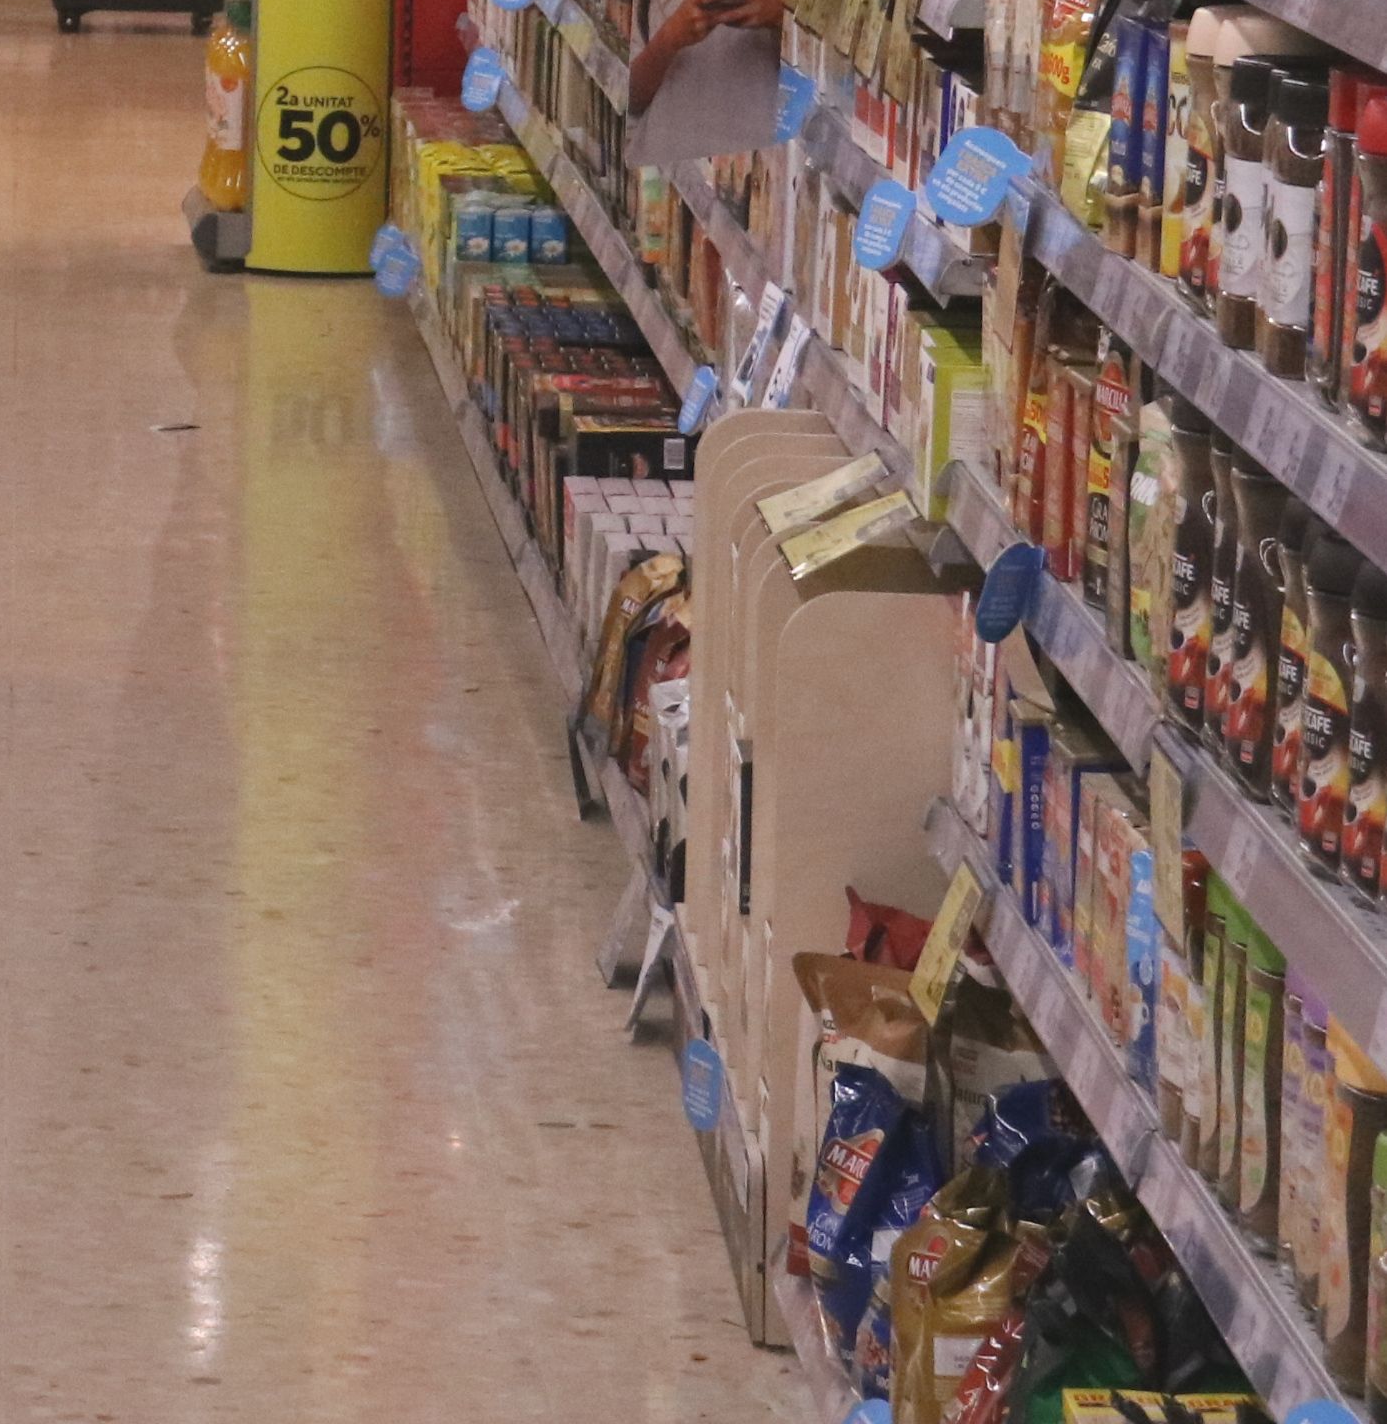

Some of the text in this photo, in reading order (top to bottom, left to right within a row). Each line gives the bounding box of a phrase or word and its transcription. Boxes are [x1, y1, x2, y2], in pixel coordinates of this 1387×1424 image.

[275, 86, 355, 108] 2a UNITAT
[276, 109, 381, 164] 50%
[273, 164, 367, 177] DE DESCOMPTE
